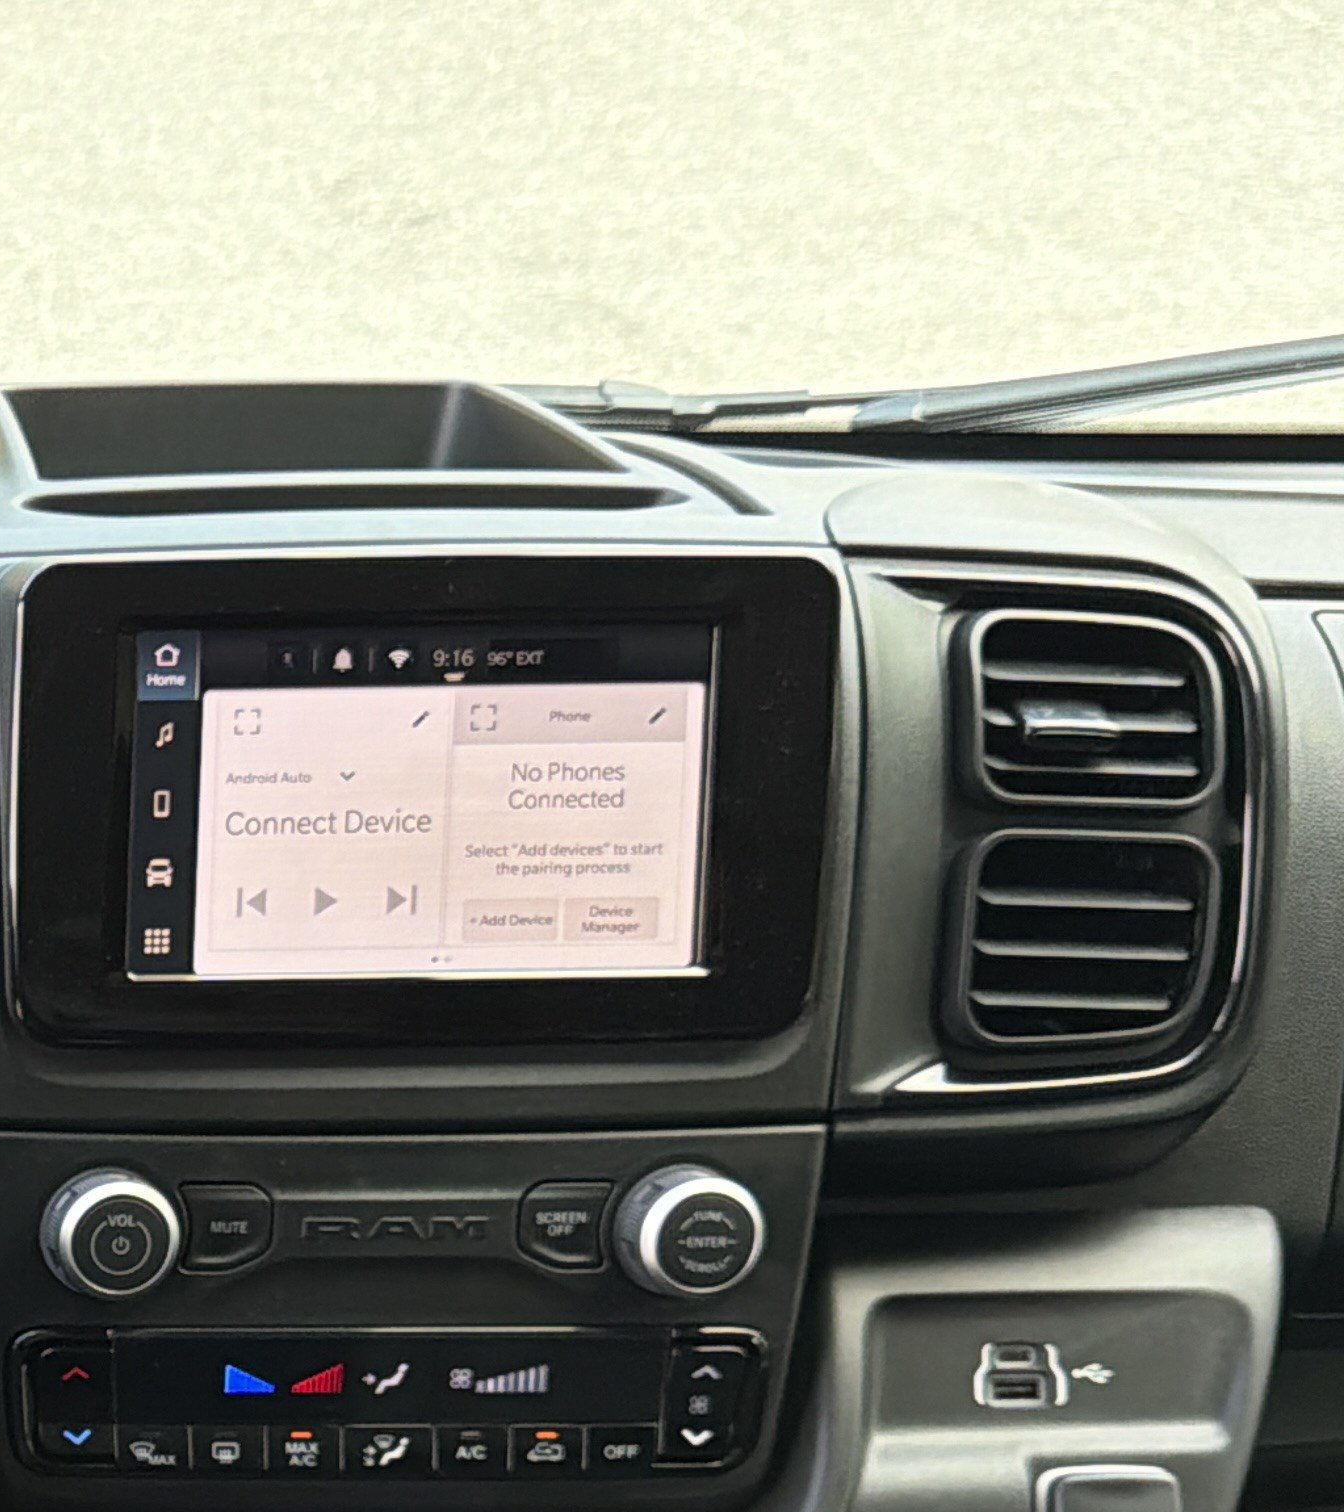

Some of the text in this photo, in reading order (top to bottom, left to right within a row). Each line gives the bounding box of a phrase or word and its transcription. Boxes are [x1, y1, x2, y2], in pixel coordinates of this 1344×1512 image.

[432, 649, 474, 667] 9:16
[516, 650, 544, 666] EXT
[146, 673, 186, 687] Home
[549, 710, 591, 722] Phone
[225, 772, 312, 784] Android Auto
[511, 762, 626, 782] No Phones
[508, 788, 626, 809] Connected
[225, 808, 432, 836] Connect Device
[465, 844, 508, 859] Select
[613, 843, 628, 856] to
[630, 842, 664, 856] start
[496, 862, 631, 877] the pairing process
[589, 905, 633, 918] Device
[480, 914, 506, 926] Add
[509, 914, 553, 926] Device
[581, 921, 640, 935] Manager
[107, 1214, 137, 1228] VOL
[535, 1211, 588, 1225] SCREEN
[210, 1221, 248, 1235] MUTE
[300, 1216, 490, 1241] RAM
[547, 1224, 574, 1237] OFF
[686, 1236, 727, 1249] ENTER
[285, 1441, 319, 1454] MAX
[455, 1444, 488, 1461] A/C
[603, 1444, 640, 1461] OFF
[148, 1455, 176, 1466] MAX
